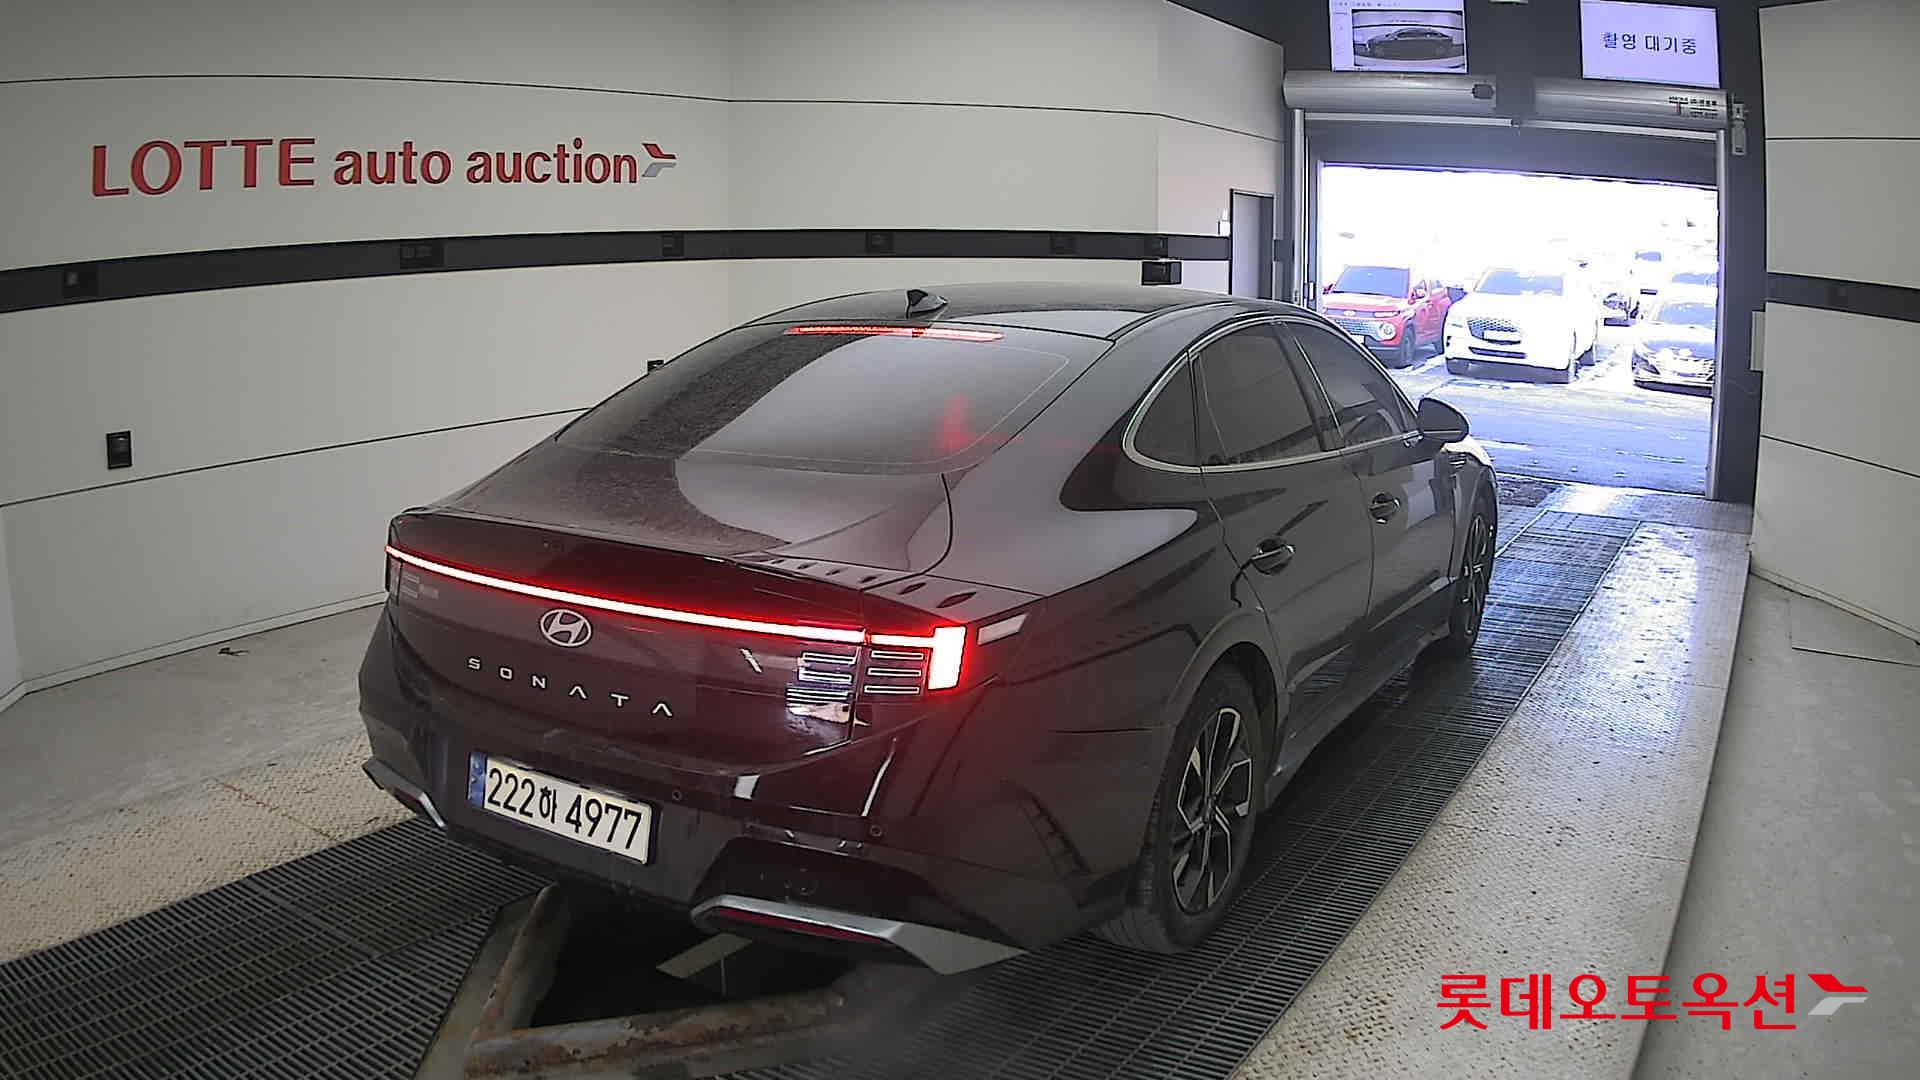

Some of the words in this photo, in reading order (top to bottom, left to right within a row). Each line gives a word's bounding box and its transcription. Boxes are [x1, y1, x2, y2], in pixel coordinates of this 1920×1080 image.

[92, 138, 316, 197] LOTTE
[334, 140, 452, 185] auto
[466, 137, 639, 184] auction
[468, 656, 673, 717] SONATA
[487, 767, 558, 825] 222하
[565, 794, 642, 849] 4977
